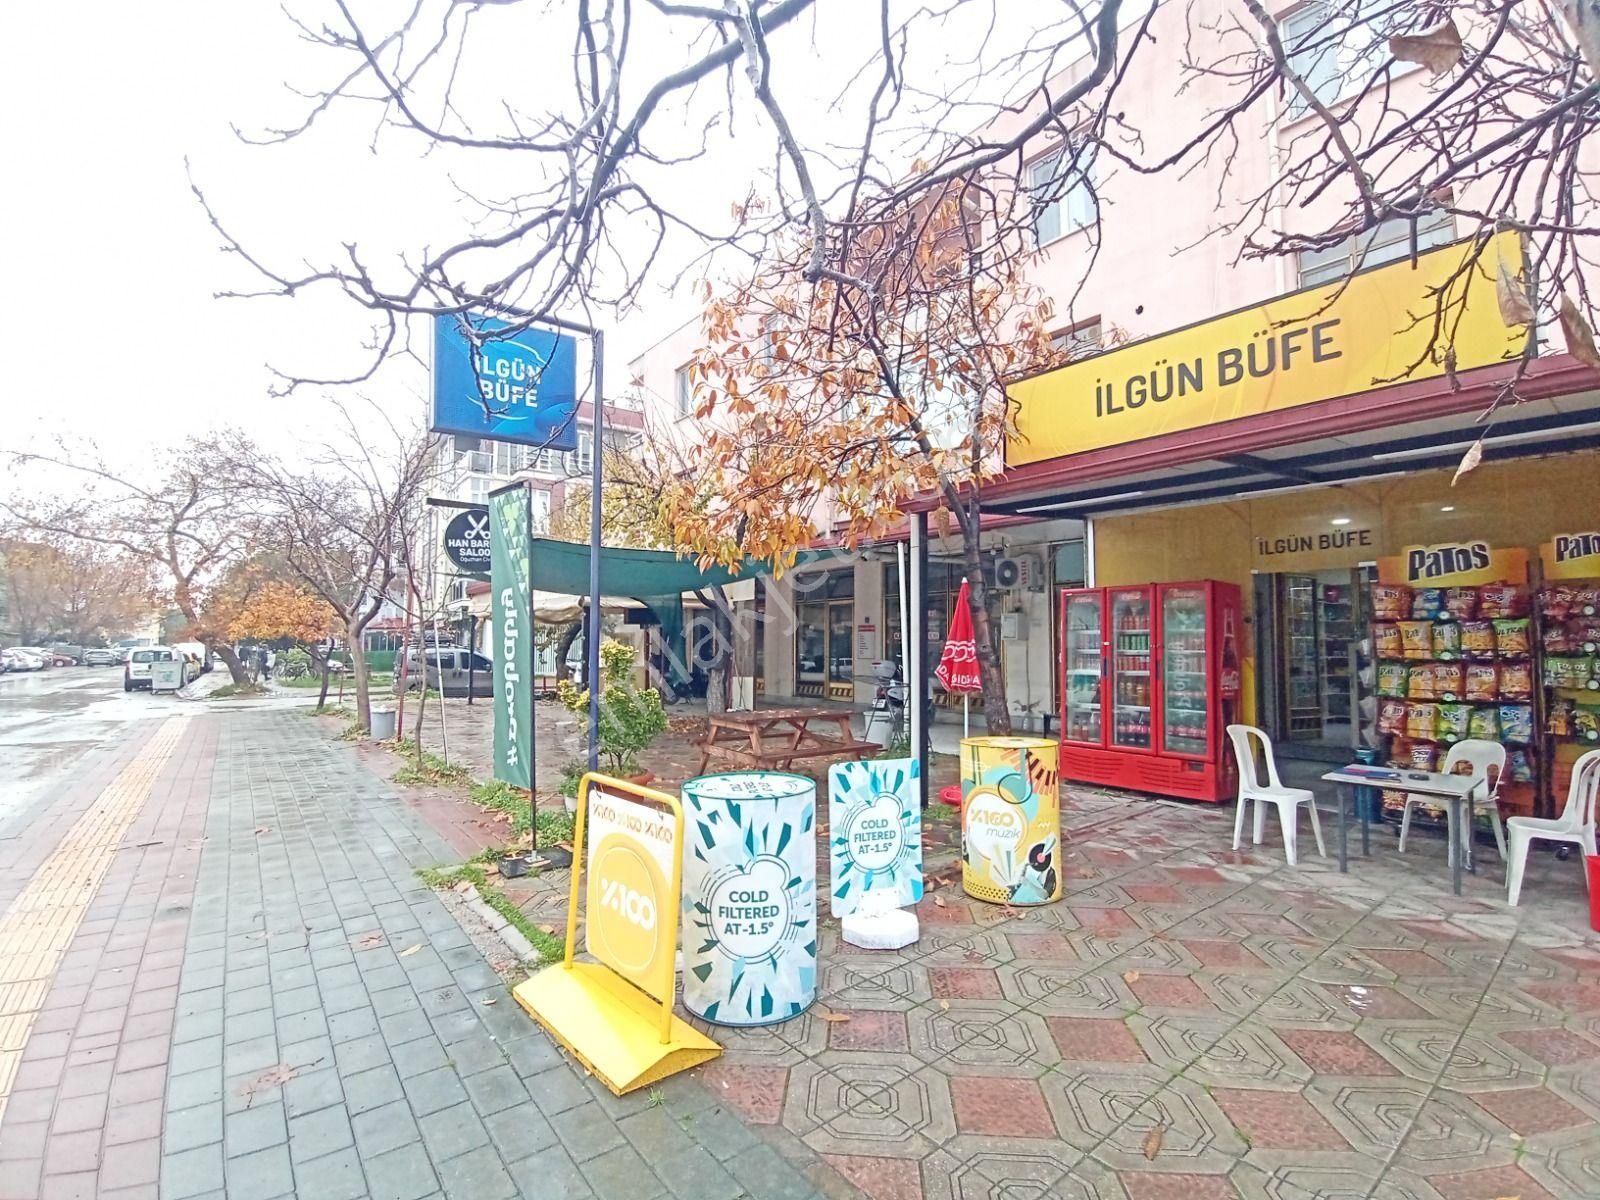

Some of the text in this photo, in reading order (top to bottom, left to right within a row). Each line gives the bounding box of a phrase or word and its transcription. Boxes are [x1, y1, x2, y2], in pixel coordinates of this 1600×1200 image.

[1095, 317, 1343, 418] İLGÜN BÜFE
[479, 377, 538, 408] BÜFE
[448, 538, 469, 548] HAN
[1259, 528, 1373, 555] İLGÜN BÜFE
[860, 818, 889, 830] COLD
[854, 829, 897, 843] FILTERED
[728, 890, 769, 903] COLD
[718, 904, 780, 920] FILTERED
